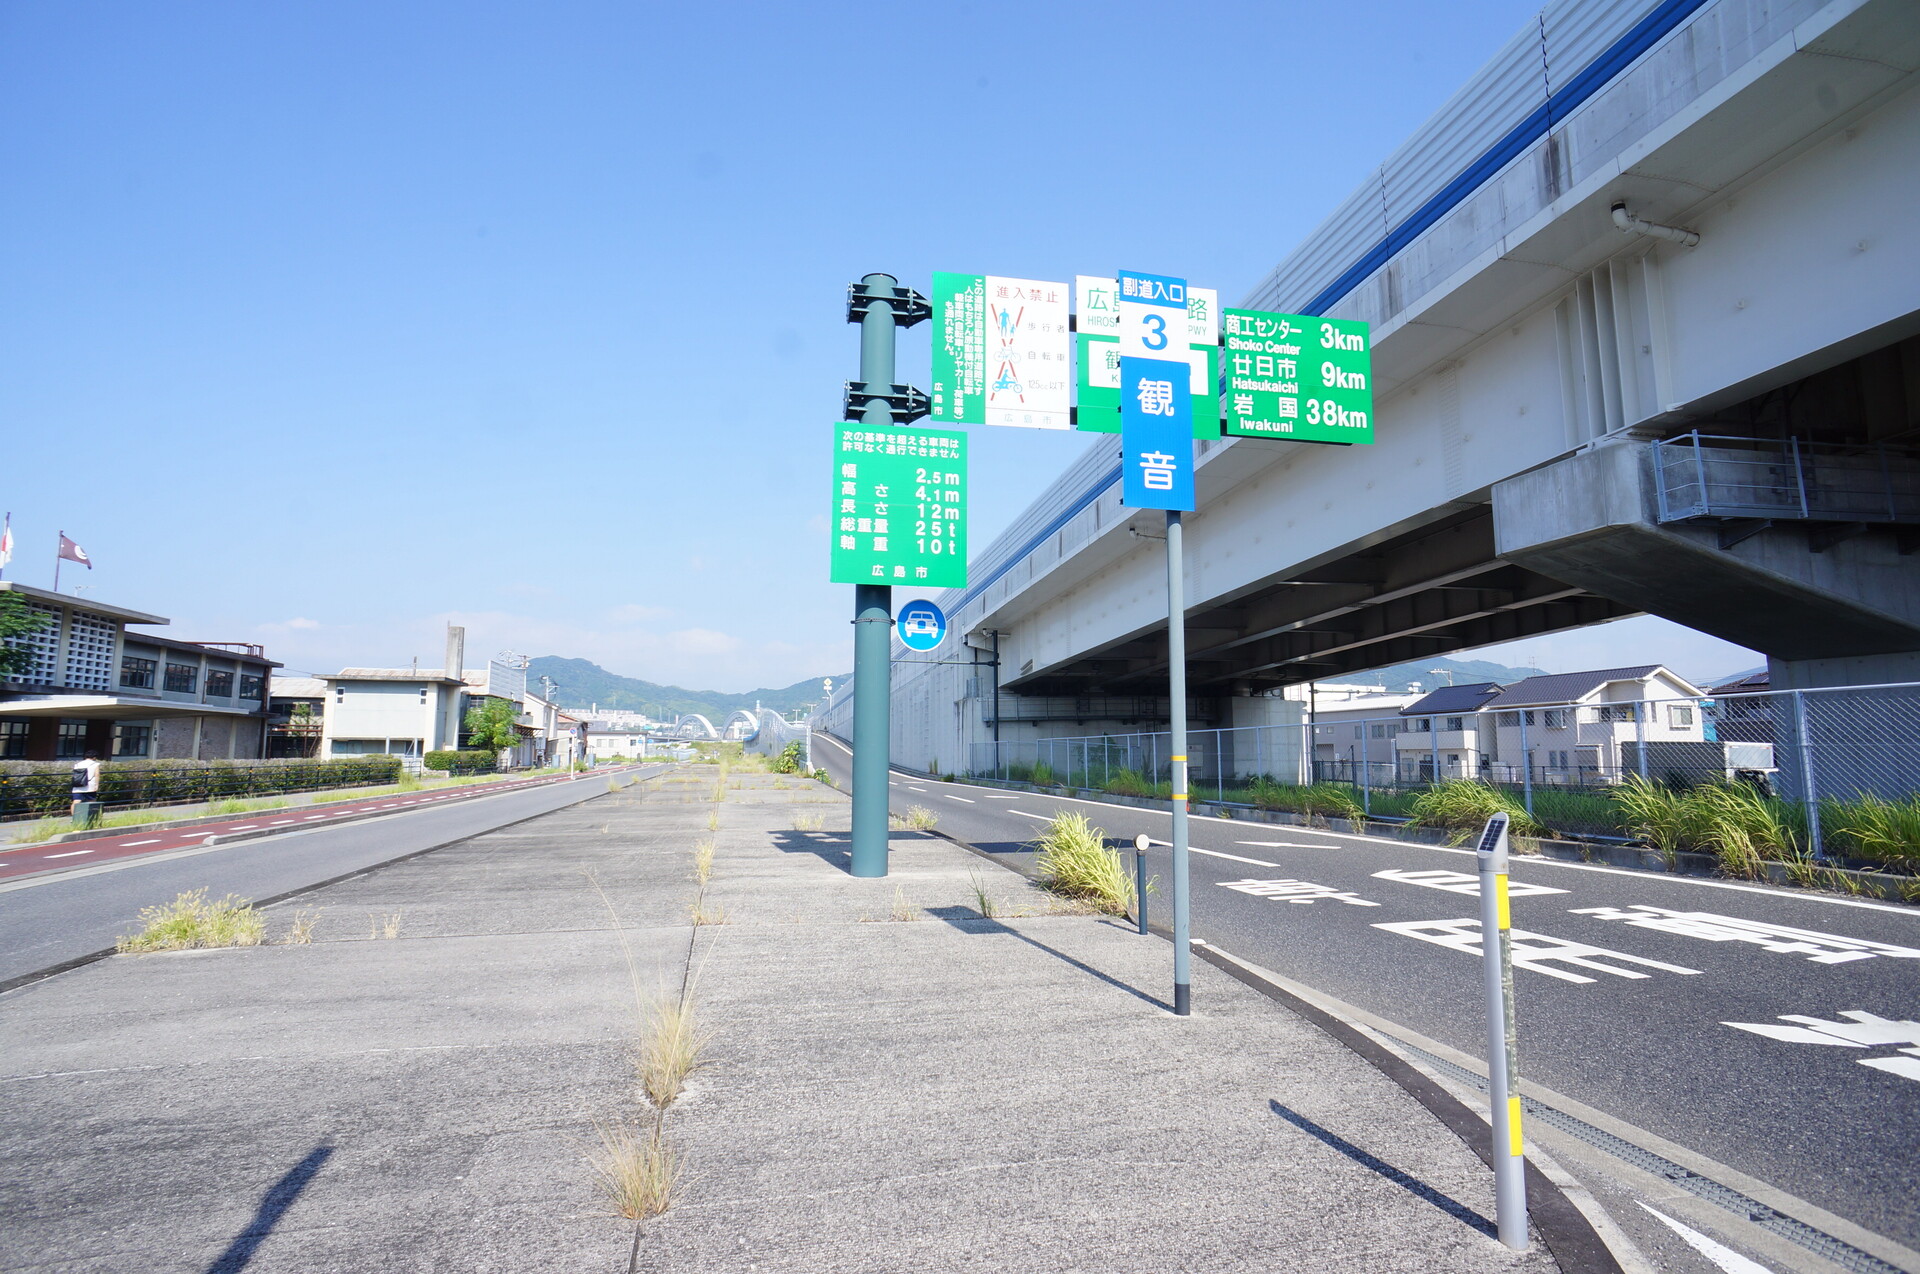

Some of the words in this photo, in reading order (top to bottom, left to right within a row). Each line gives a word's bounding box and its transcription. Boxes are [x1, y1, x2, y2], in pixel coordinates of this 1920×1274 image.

[997, 285, 1059, 303] 進入禁止
[1123, 277, 1184, 303] 副道入口
[1028, 321, 1065, 334] 歩行者
[1141, 313, 1168, 350] 3
[1188, 325, 1207, 337] PWY
[1226, 314, 1302, 339] 商工センター
[1320, 323, 1364, 352] 3km
[1228, 337, 1263, 352] Shoko
[1265, 341, 1301, 356] Center
[1028, 350, 1065, 362] 自転車
[1232, 353, 1297, 379] 廿日市
[1321, 361, 1366, 390] 9km
[1232, 377, 1299, 394] Hatsukaichi
[934, 382, 943, 416] 広島市
[1004, 413, 1052, 425] 広島市
[1233, 393, 1299, 419] 岩国
[1306, 398, 1368, 429] 38km
[1137, 377, 1177, 490] 観音
[1240, 417, 1293, 433] Iwakuni
[842, 430, 960, 449] 次の基準を超える車両は
[842, 441, 960, 459] 許可なく通行できません
[841, 463, 857, 479] 幅
[841, 481, 889, 498] 高さ
[840, 499, 889, 516] 長さ
[840, 516, 889, 534] 総重量
[840, 534, 889, 552] 軸重
[871, 564, 928, 579] 広島市
